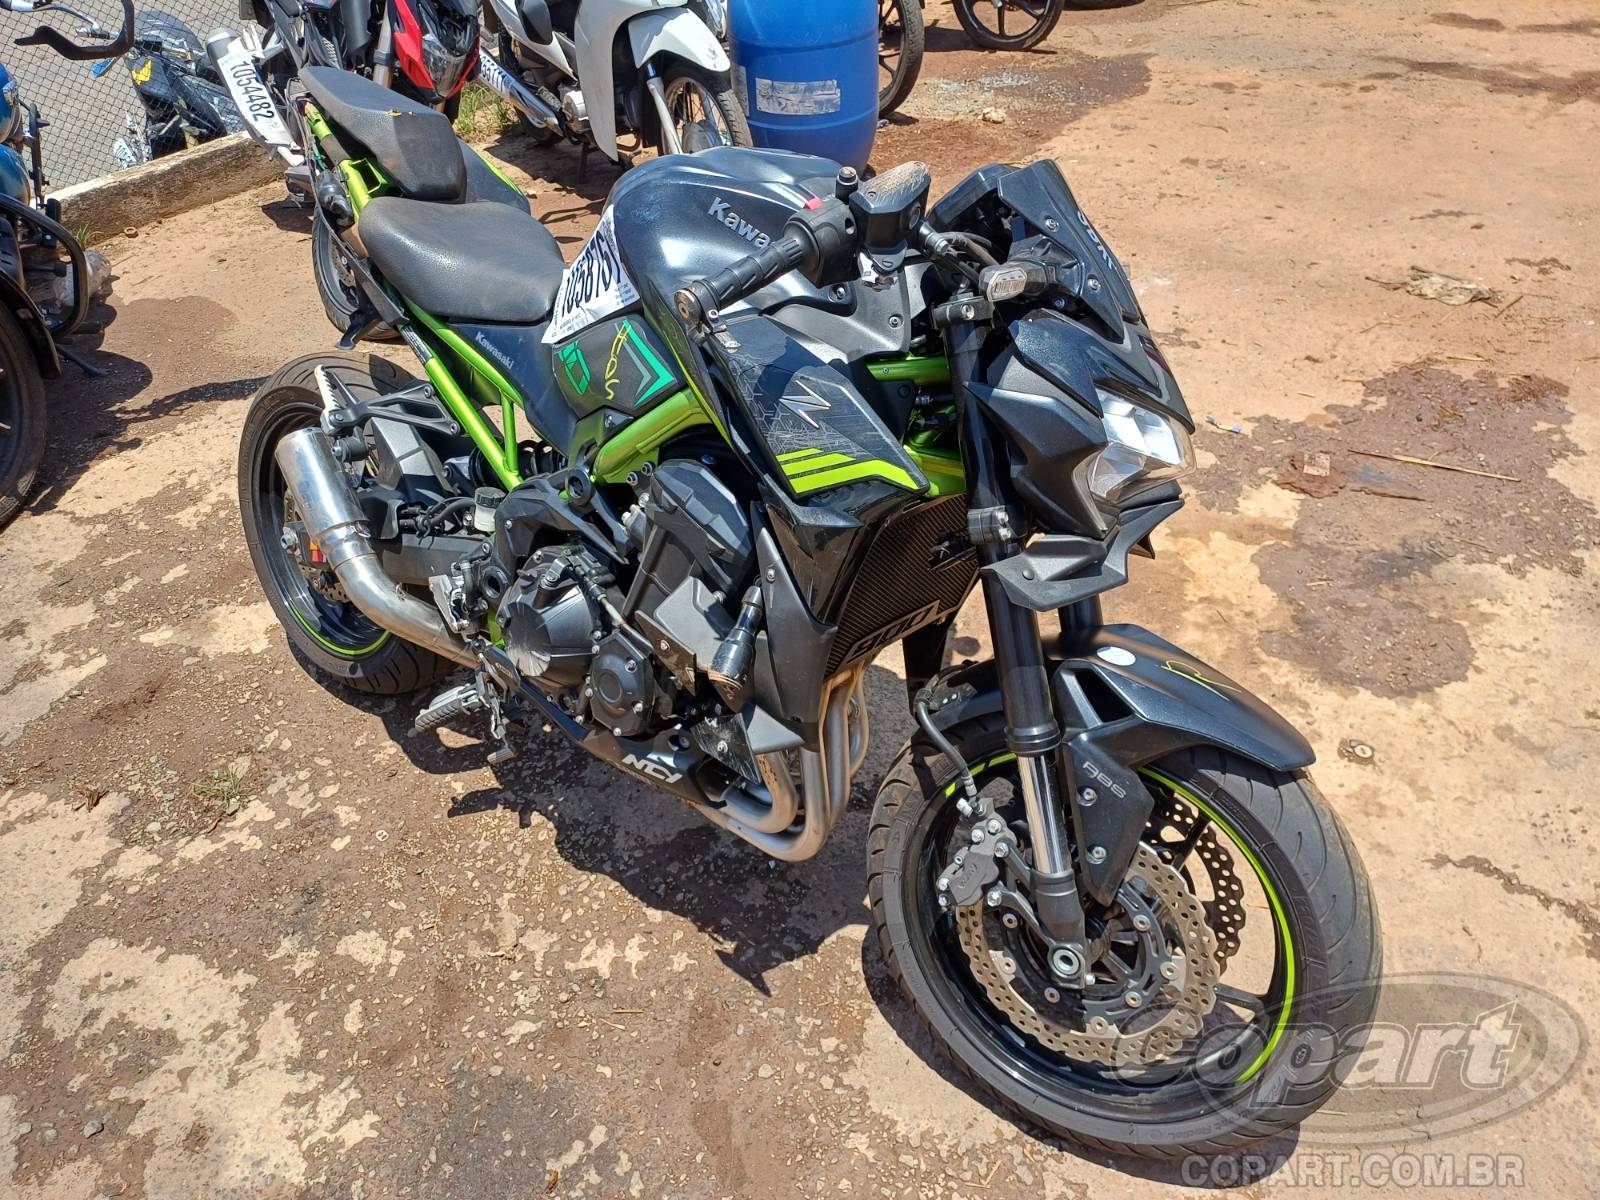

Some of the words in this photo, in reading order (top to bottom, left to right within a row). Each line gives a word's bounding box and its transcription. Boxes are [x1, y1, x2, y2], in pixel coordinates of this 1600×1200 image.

[230, 60, 275, 121] 1054482
[707, 196, 771, 249] Kawa
[475, 331, 514, 369] Kawasaki
[1083, 761, 1126, 798] ABS
